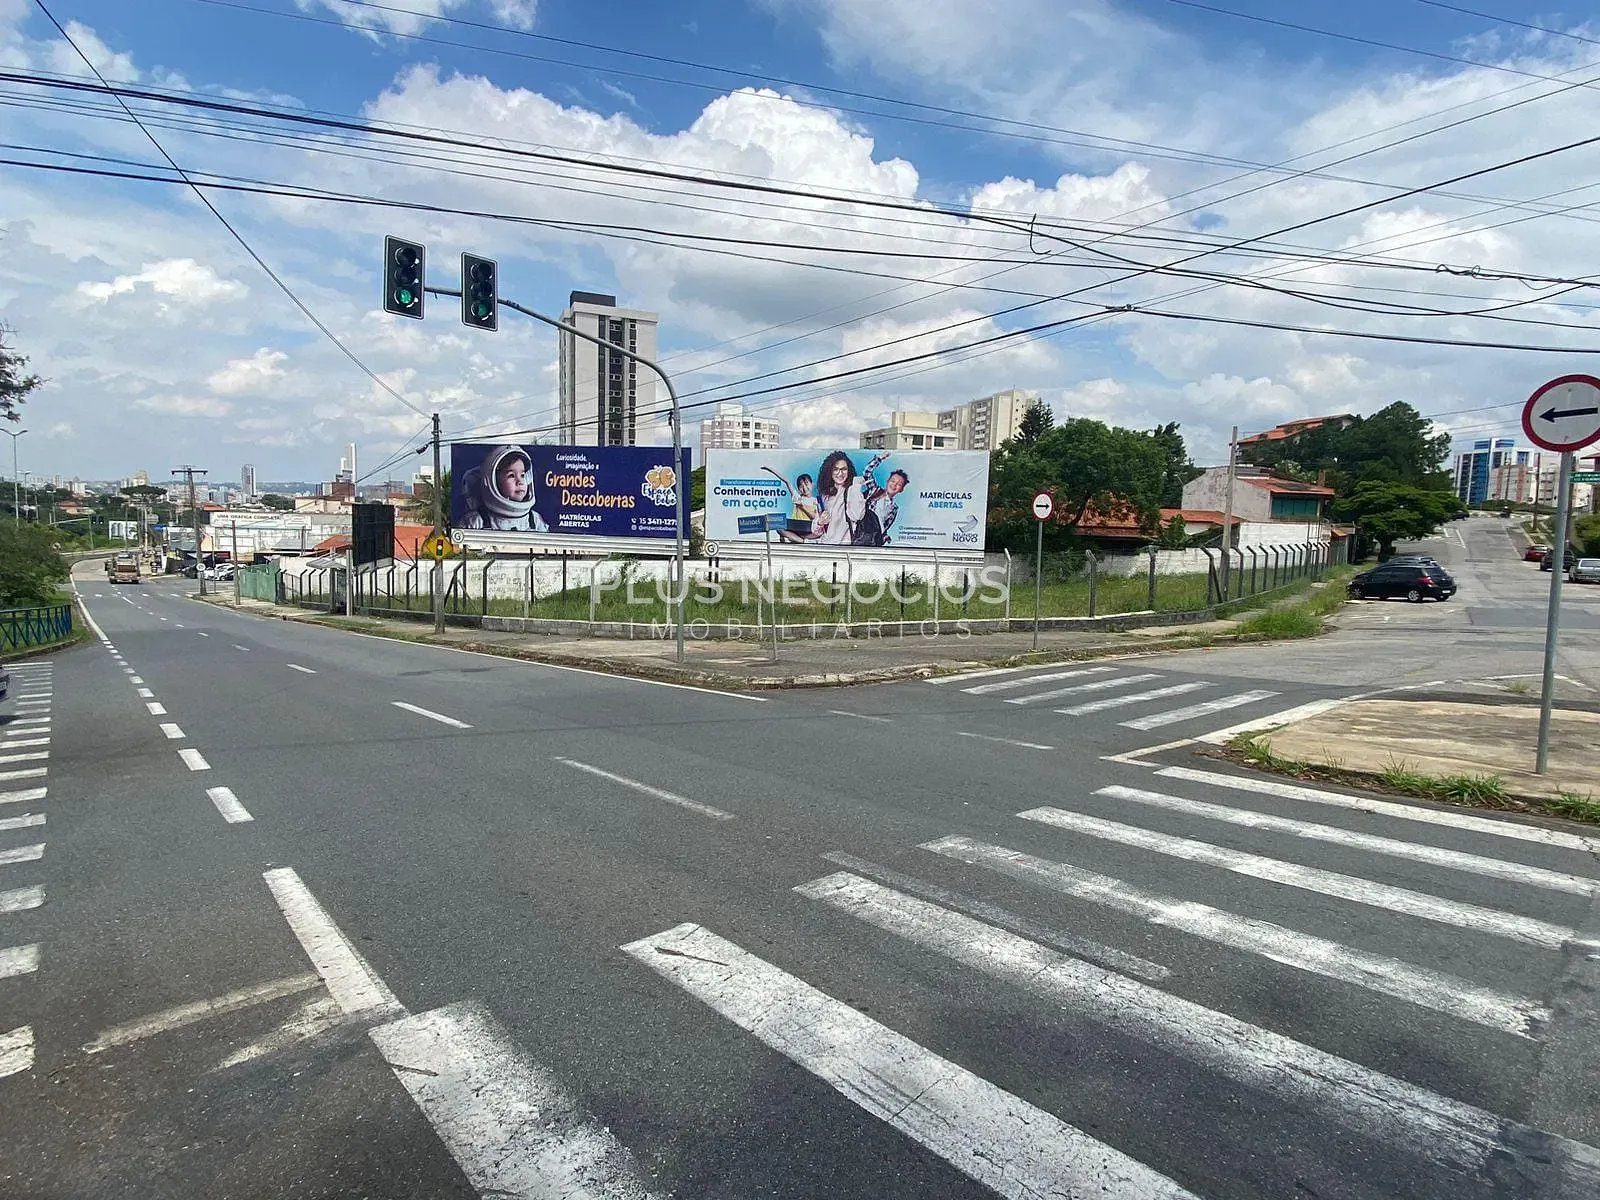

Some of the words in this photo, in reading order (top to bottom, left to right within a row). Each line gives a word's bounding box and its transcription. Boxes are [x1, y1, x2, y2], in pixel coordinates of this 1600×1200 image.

[546, 471, 595, 488] Grandes
[713, 486, 787, 497] Conhecimento
[920, 490, 973, 500] MATRÍCULAS
[562, 489, 635, 508] Descobertas
[722, 499, 741, 507] em
[743, 497, 778, 510] ação!
[928, 501, 964, 509] ABERTAS
[559, 513, 602, 522] MATRÍCULAS
